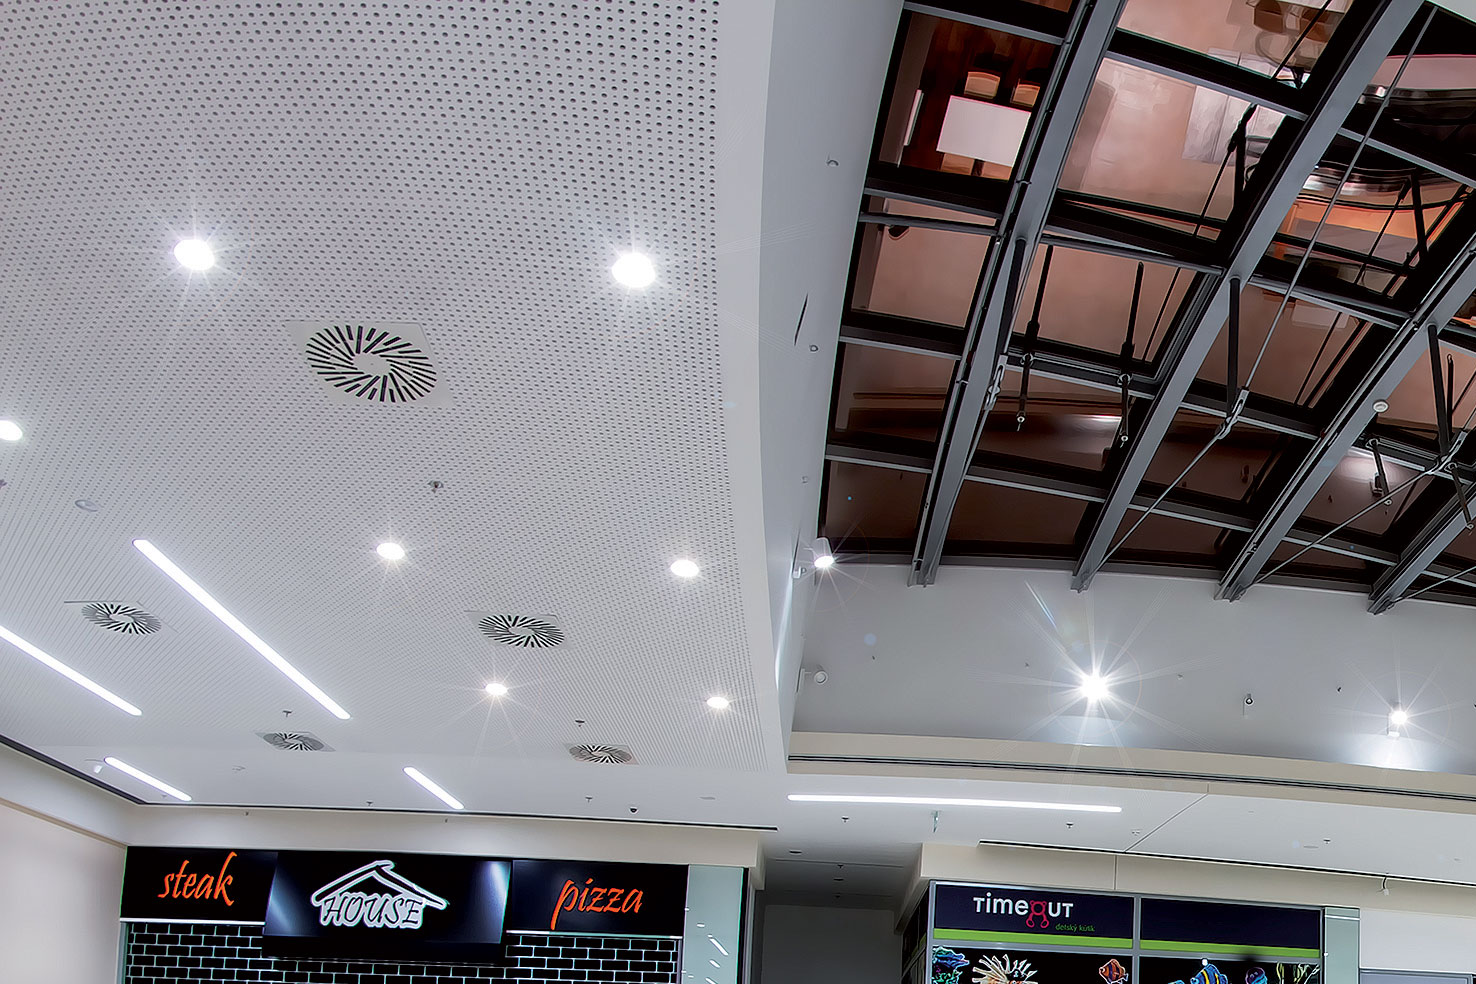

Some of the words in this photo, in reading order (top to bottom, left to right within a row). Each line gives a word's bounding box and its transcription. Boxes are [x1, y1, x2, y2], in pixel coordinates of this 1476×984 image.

[157, 851, 238, 907] steak
[550, 878, 644, 931] pizza
[321, 893, 424, 926] HOUSE
